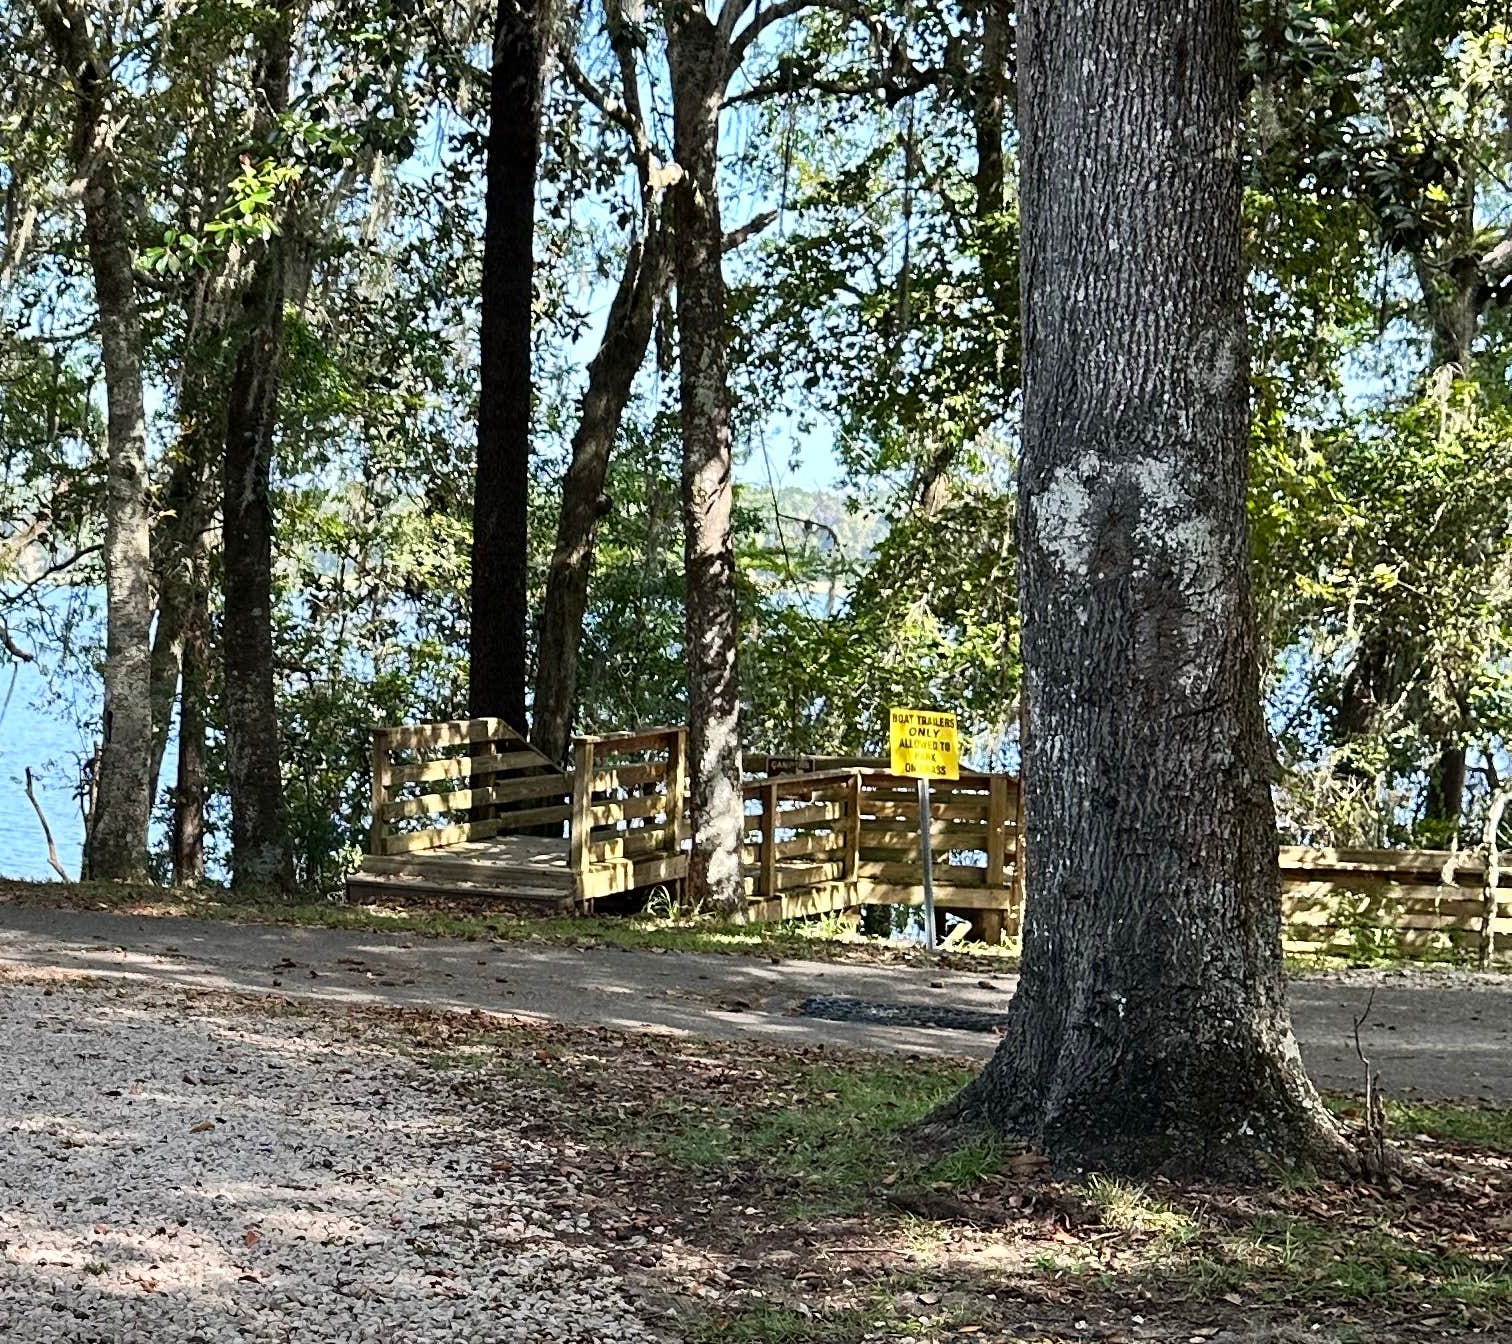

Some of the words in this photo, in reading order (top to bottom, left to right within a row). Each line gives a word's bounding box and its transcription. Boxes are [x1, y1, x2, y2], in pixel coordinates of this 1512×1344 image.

[892, 713, 914, 724] BOAT
[917, 715, 955, 728] TRAILERS
[909, 728, 940, 738] ONLY
[899, 738, 938, 751] ALLOWED
[940, 741, 951, 753] TO
[905, 762, 916, 773] ON
